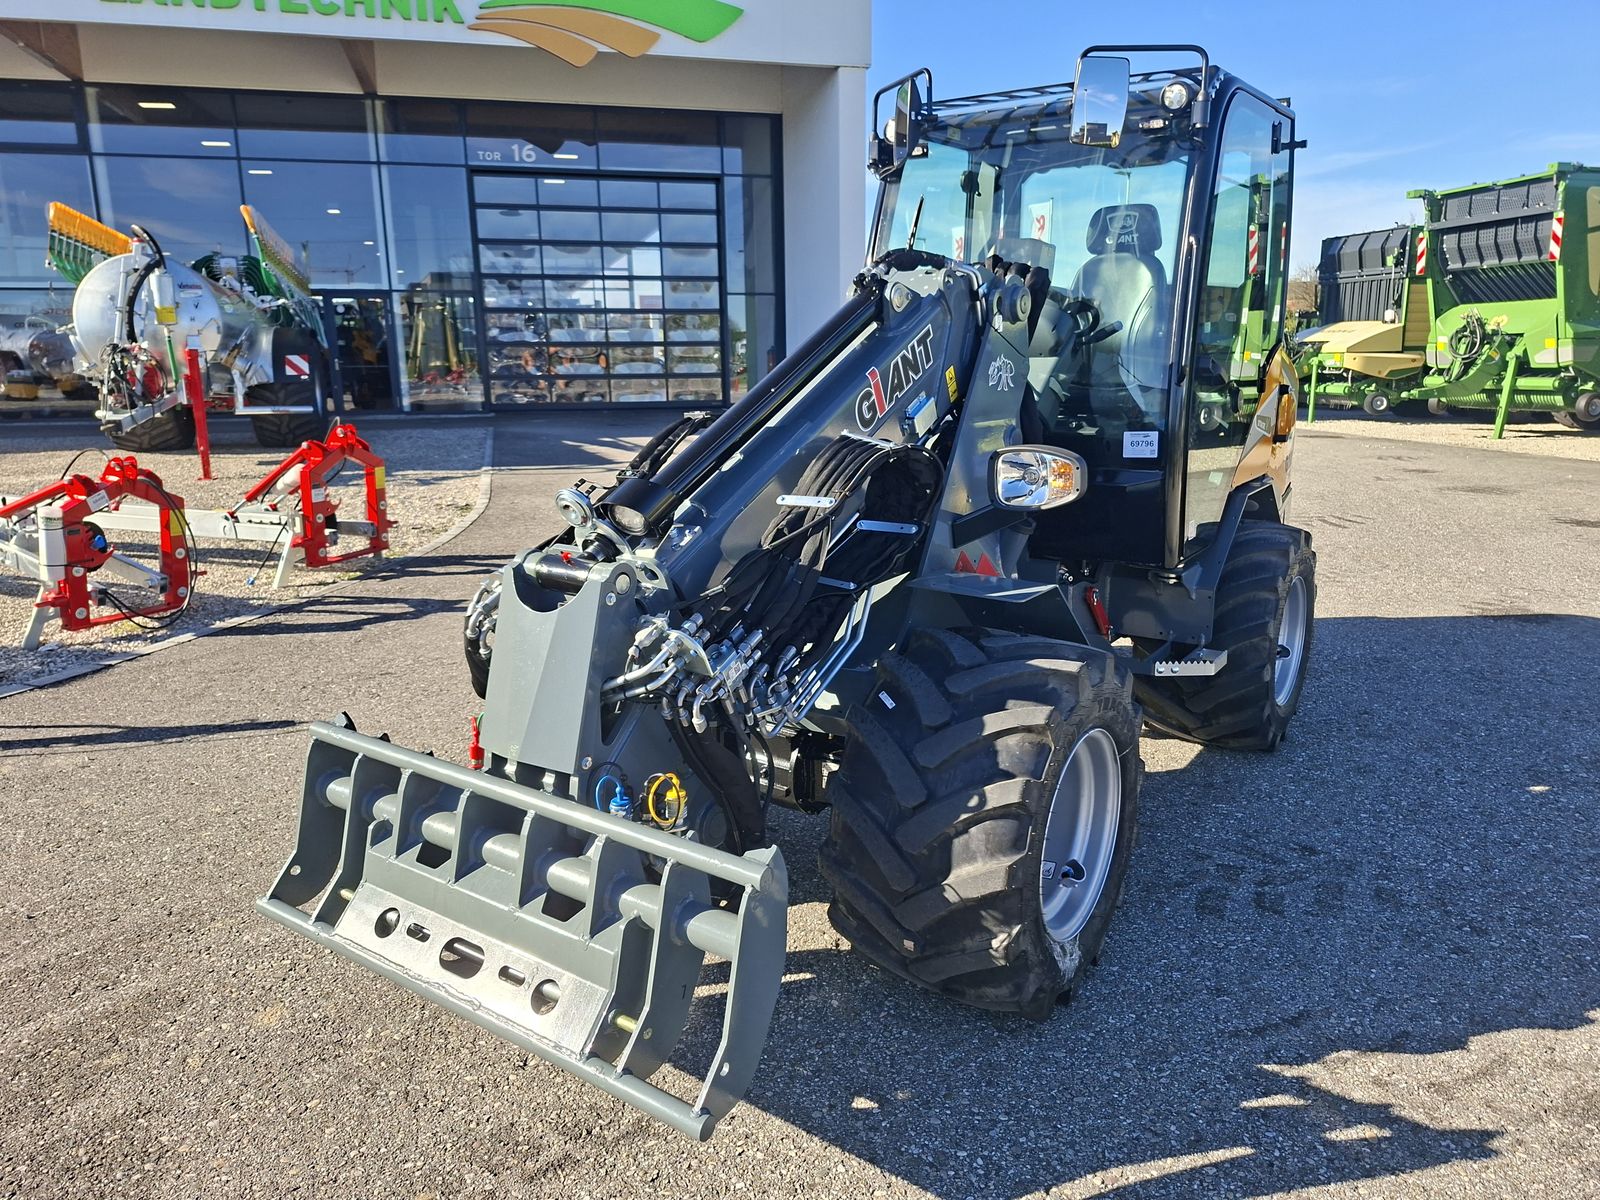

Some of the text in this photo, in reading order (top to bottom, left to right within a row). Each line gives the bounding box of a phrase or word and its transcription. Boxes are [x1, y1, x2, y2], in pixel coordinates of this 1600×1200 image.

[477, 143, 536, 163] TOR 16
[1105, 233, 1139, 245] GANT
[1130, 440, 1155, 448] 69796
